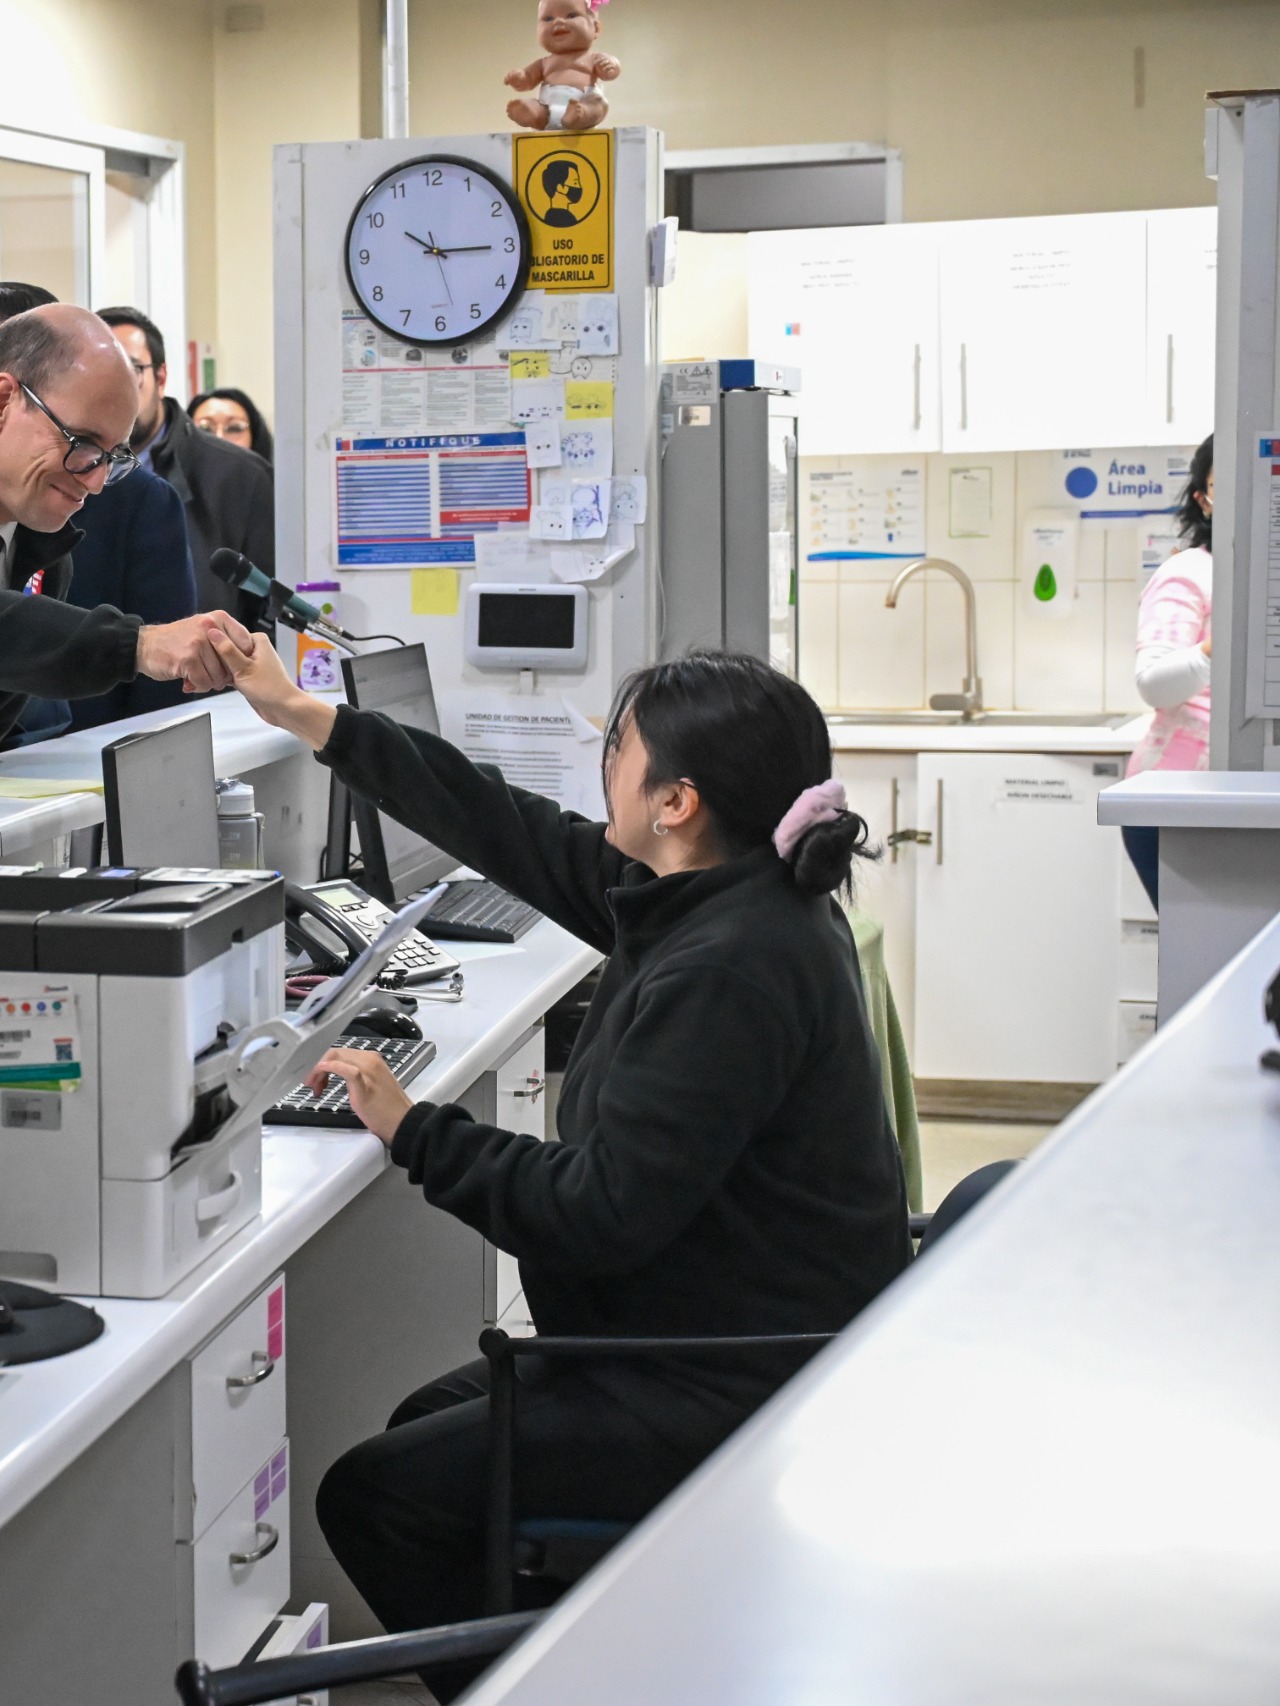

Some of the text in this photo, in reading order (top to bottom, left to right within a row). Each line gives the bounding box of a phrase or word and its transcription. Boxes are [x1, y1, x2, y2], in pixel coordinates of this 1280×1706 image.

[422, 169, 443, 186] 12
[463, 176, 471, 192] 1
[389, 182, 405, 199] 11
[491, 201, 503, 217] 2
[366, 212, 384, 228] 10
[503, 237, 516, 253] 3
[553, 239, 574, 250] USO
[359, 249, 370, 265] 9
[529, 254, 605, 267] BLIGATORIO DE
[494, 274, 507, 290] 4
[531, 270, 595, 282] MASCARILLA
[372, 285, 384, 301] 8
[399, 309, 412, 326] 7
[470, 303, 482, 319] 5
[434, 316, 446, 332] 6
[385, 436, 481, 448] NOTIFIQUE
[1108, 457, 1146, 475] Área
[1108, 480, 1163, 498] Limpia
